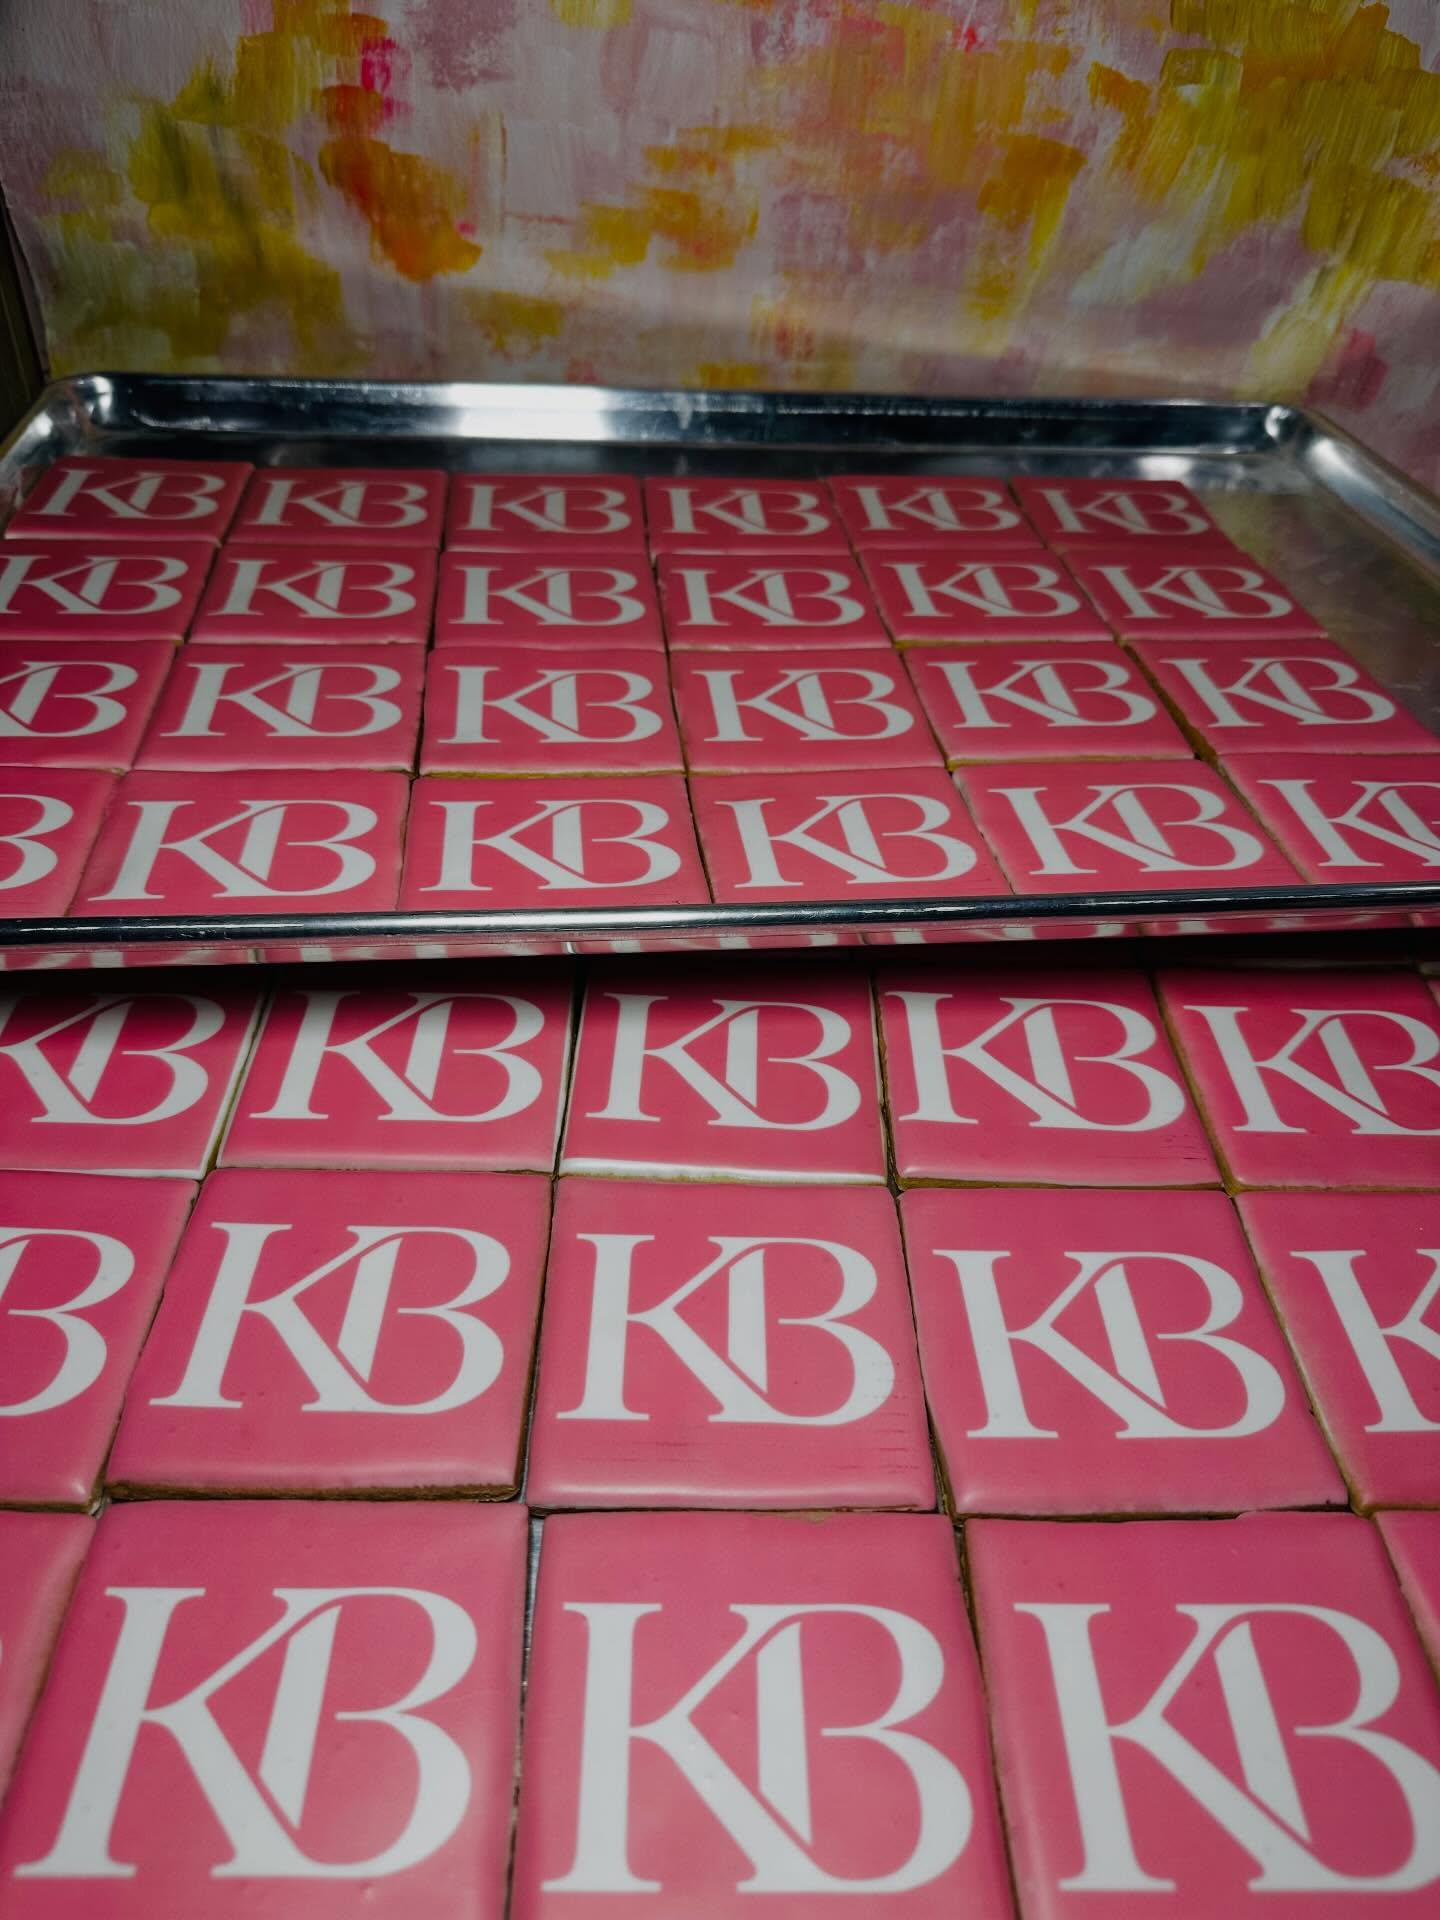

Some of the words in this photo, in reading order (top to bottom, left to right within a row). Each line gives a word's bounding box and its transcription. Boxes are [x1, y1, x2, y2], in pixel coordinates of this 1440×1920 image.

[31, 468, 226, 520] KB
[247, 479, 429, 528] KB
[458, 484, 631, 533] KB
[651, 488, 831, 536] KB
[845, 486, 1020, 532] KB
[1037, 489, 1210, 536] KB
[208, 560, 417, 619] KB
[450, 566, 645, 626] KB
[677, 569, 865, 626] KB
[885, 562, 1081, 618] KB
[1089, 566, 1293, 619] KB
[160, 662, 402, 737] KB
[438, 666, 663, 744] KB
[693, 668, 914, 742] KB
[927, 660, 1157, 729] KB
[1160, 657, 1396, 728] KB
[0, 794, 74, 890] B
[88, 799, 378, 901] KB
[420, 799, 681, 892] KB
[715, 794, 977, 888] KB
[988, 784, 1265, 874] KB
[250, 991, 545, 1122] KB
[585, 992, 861, 1131] KB
[886, 992, 1186, 1133] KB
[0, 1225, 135, 1417] B
[149, 1221, 511, 1415] KB
[556, 1232, 896, 1428] KB
[932, 1248, 1286, 1439] KB
[1290, 1249, 1440, 1433] K
[14, 1585, 481, 1882] KB
[540, 1602, 974, 1896] KB
